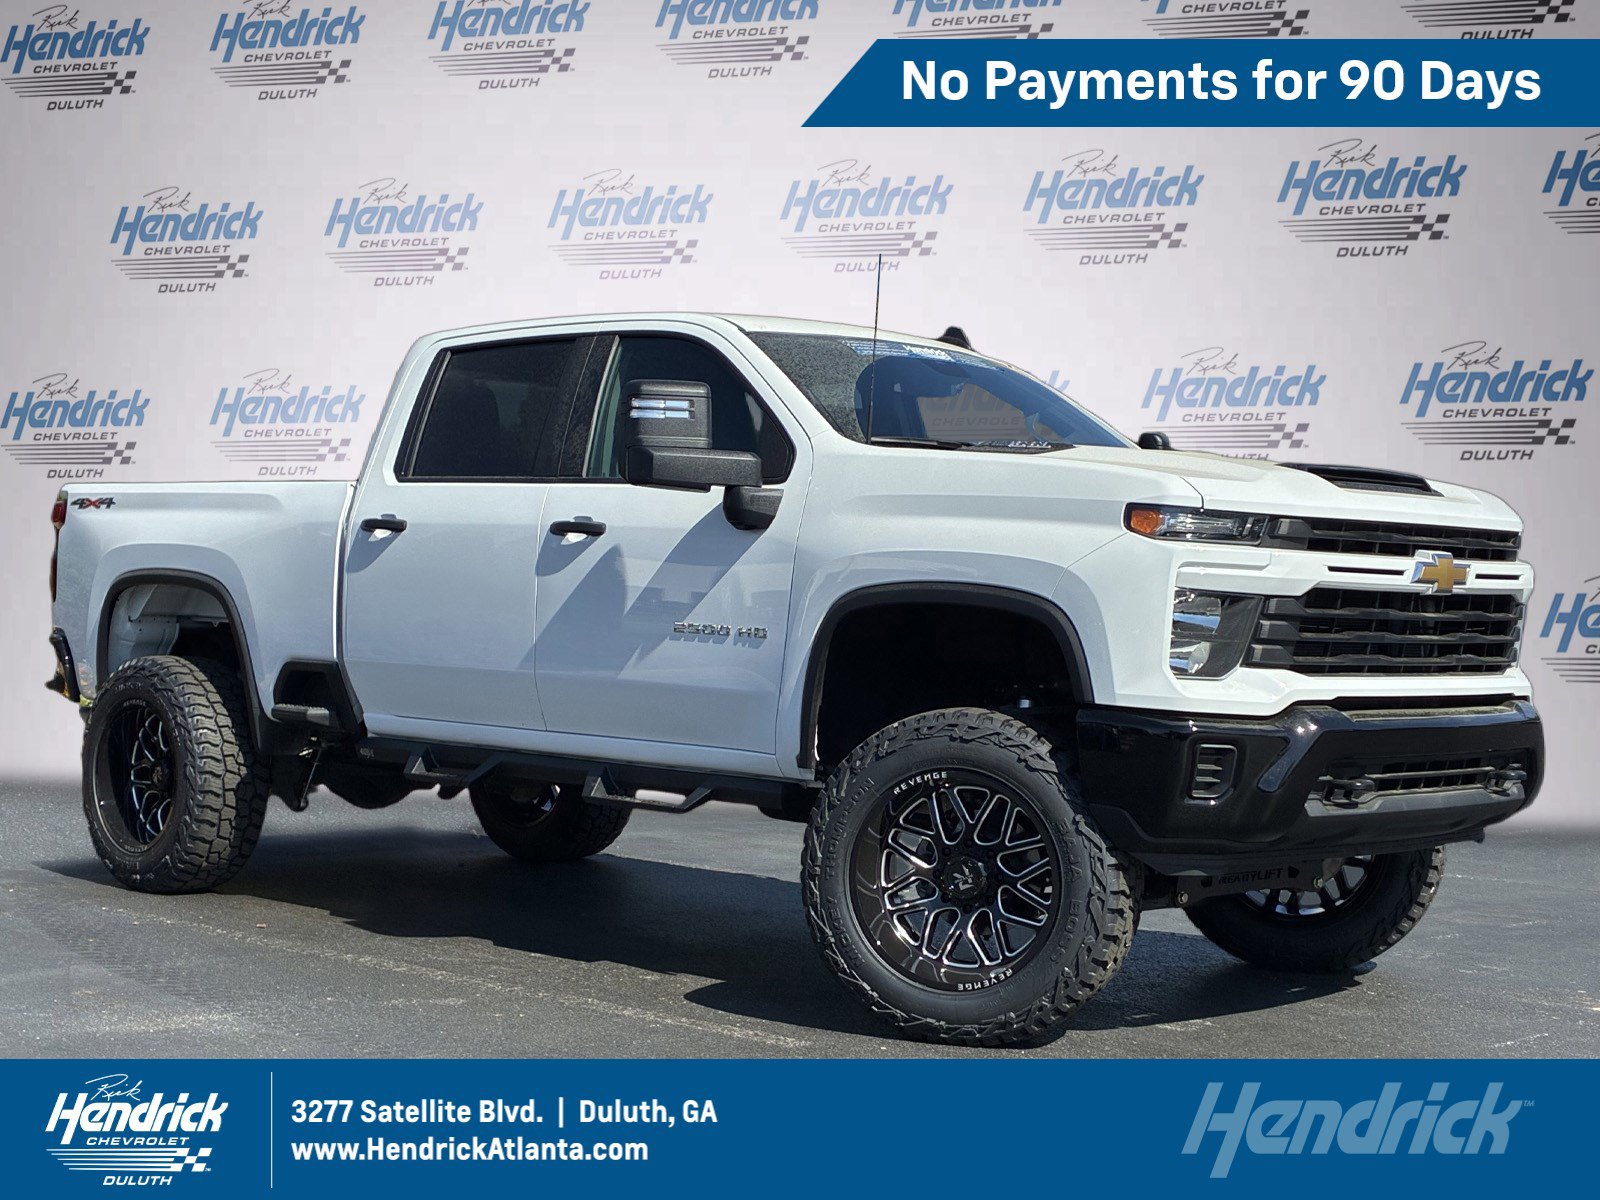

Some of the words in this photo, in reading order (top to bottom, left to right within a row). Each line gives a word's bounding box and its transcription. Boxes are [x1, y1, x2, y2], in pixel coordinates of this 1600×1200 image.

[1182, 0, 1286, 13] CHEVROLET
[428, 0, 590, 51] Hendrick
[931, 13, 1032, 27] CHEVROLET
[210, 6, 366, 63] Hendrick
[692, 26, 788, 39] CHEVROLET
[0, 18, 149, 74] Hendrick
[464, 39, 555, 51] CHEVROLET
[244, 50, 332, 63] CHEVROLET
[33, 62, 118, 74] CHEVROLET
[708, 66, 772, 78] DULUTH
[478, 78, 540, 90] DULUTH
[258, 89, 318, 100] DULUTH
[47, 99, 104, 111] DULUTH
[1278, 154, 1467, 215] Hendrick
[1024, 165, 1204, 224] Hendrick
[781, 175, 953, 233] Hendrick
[1319, 203, 1426, 215] CHEVROLET
[548, 184, 712, 240] Hendrick
[1063, 212, 1165, 224] CHEVROLET
[325, 193, 483, 248] Hendrick
[111, 202, 263, 256] Hendrick
[818, 221, 916, 233] CHEVROLET
[584, 230, 678, 241] CHEVROLET
[359, 237, 450, 248] CHEVROLET
[144, 245, 230, 256] CHEVROLET
[1336, 245, 1408, 258] DULUTH
[1079, 253, 1148, 265] DULUTH
[833, 261, 900, 273] DULUTH
[599, 268, 662, 280] DULUTH
[158, 282, 216, 293] DULUTH
[373, 276, 435, 287] DULUTH
[1142, 364, 1327, 421] Hendrick
[1400, 359, 1594, 418] Hendrick
[0, 389, 149, 441] Hendrick
[210, 385, 365, 438] Hendrick
[1182, 412, 1287, 422] CHEVROLET
[1443, 407, 1552, 418] CHEVROLET
[932, 416, 1019, 427] CHEVROLE
[33, 432, 118, 441] CHEVROLET
[244, 429, 332, 438] CHEVROLET
[1460, 449, 1534, 461] DULUTH
[47, 469, 104, 479] DULUTH
[258, 466, 318, 476] DULUTH
[893, 770, 949, 795] REVENGE
[957, 968, 1012, 991] REVENGE
